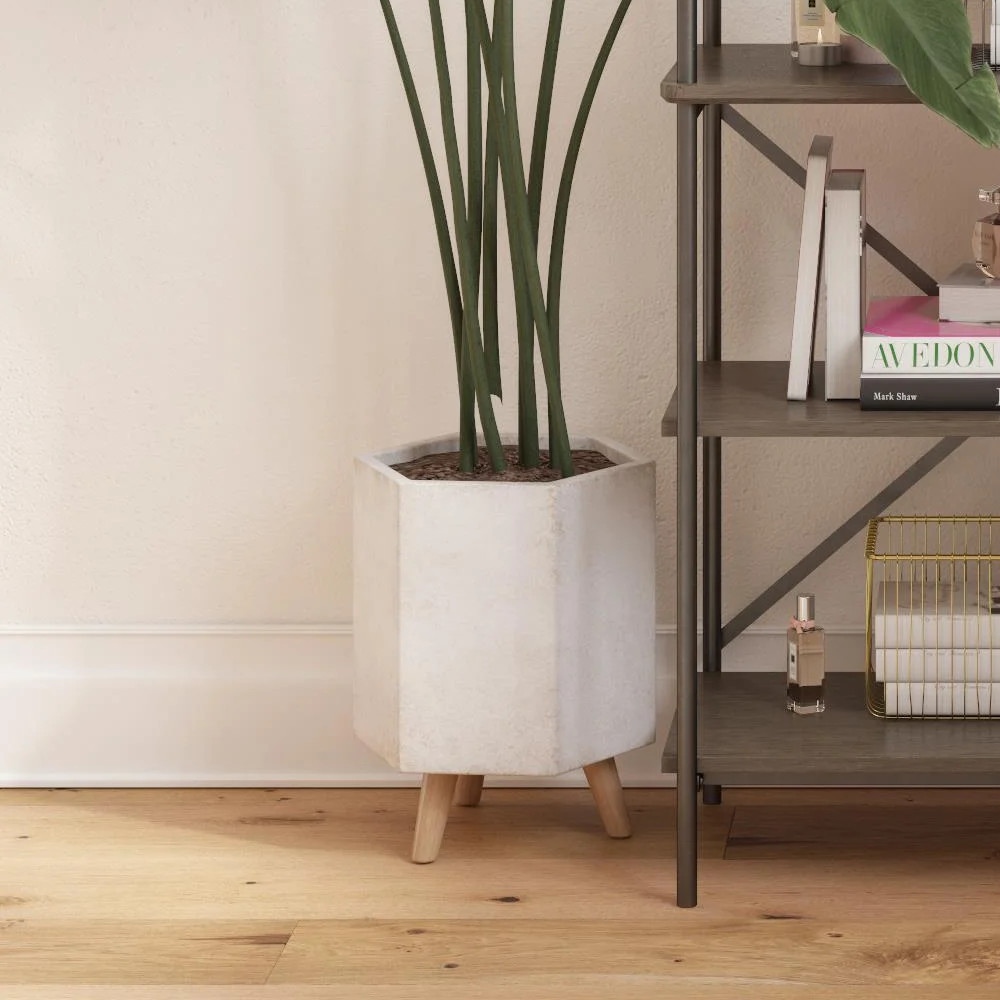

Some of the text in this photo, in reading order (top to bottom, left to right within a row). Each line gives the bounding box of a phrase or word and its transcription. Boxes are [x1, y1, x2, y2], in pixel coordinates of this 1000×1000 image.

[871, 341, 996, 369] AVEDON
[873, 391, 894, 401] Mark
[896, 391, 917, 401] Shaw
